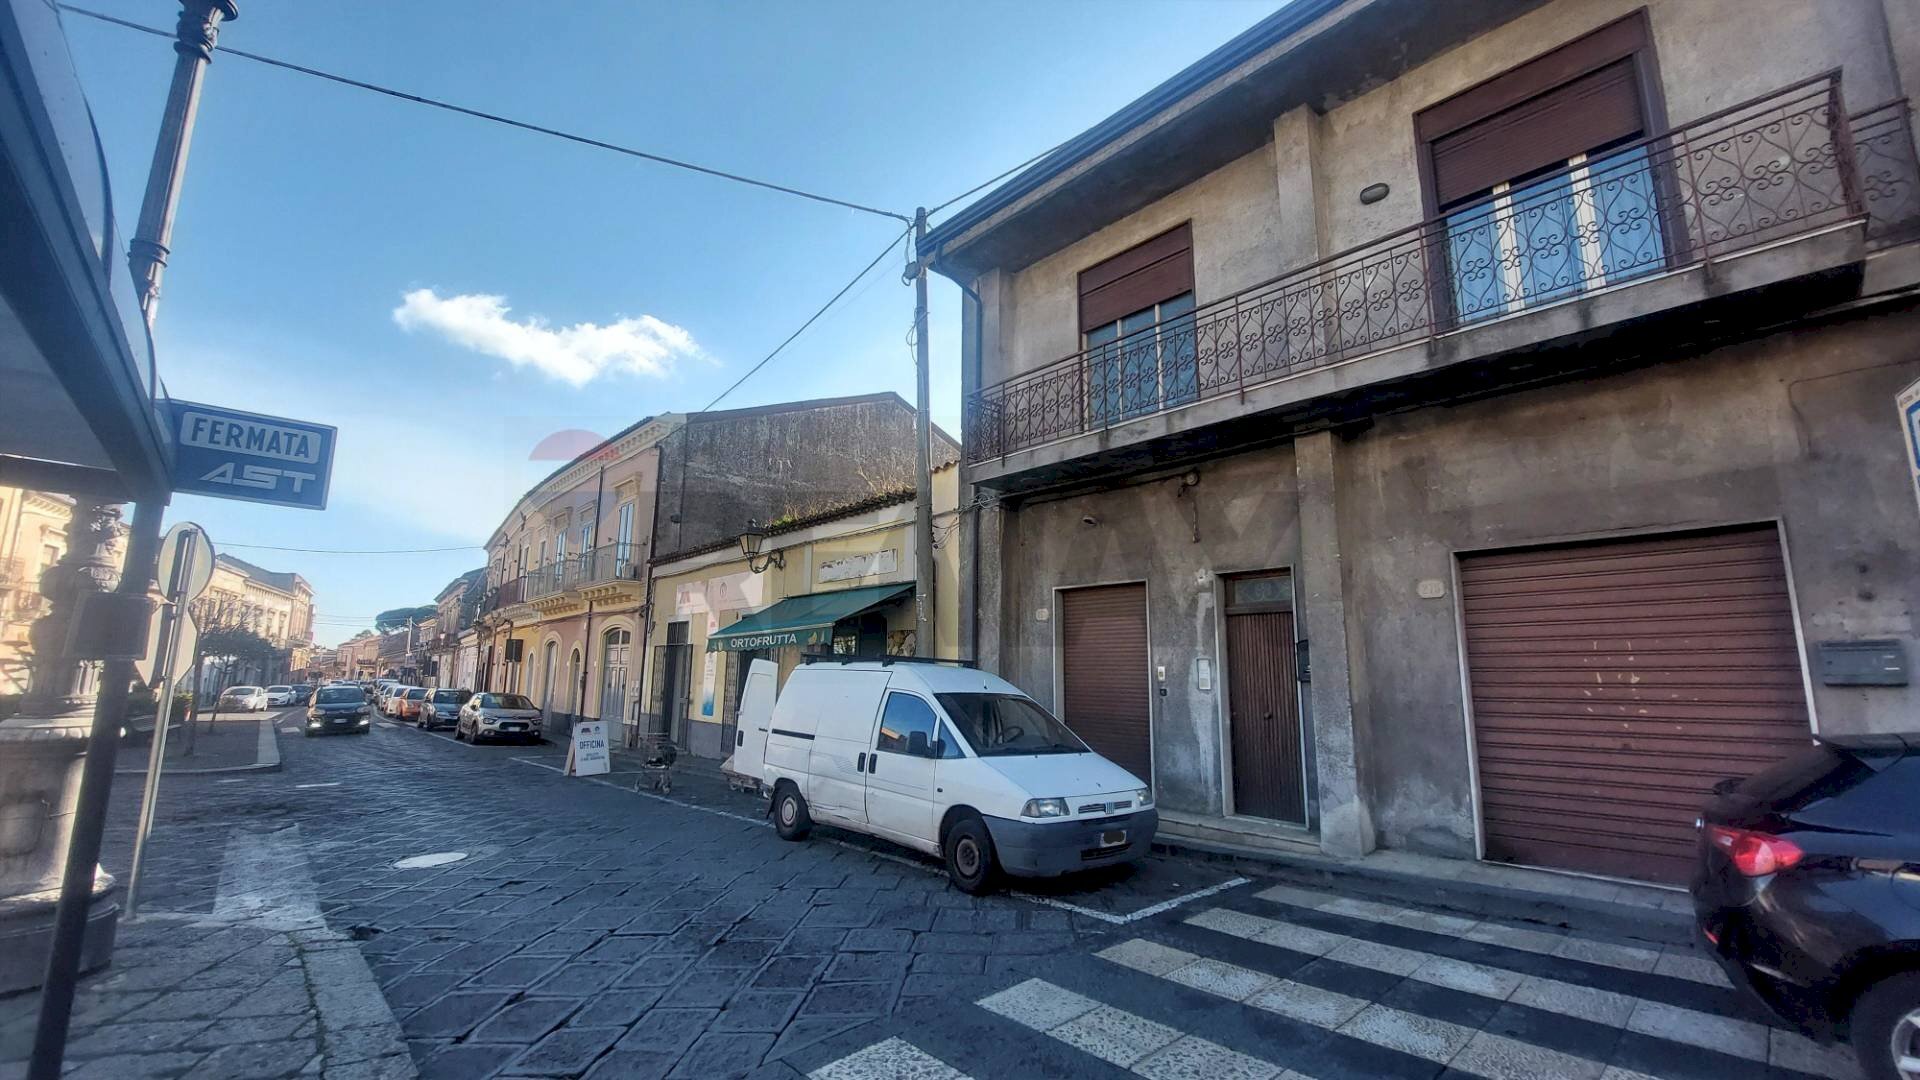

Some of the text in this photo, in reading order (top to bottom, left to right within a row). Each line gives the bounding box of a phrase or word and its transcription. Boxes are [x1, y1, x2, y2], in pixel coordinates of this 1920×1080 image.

[191, 417, 310, 459] FERMATA
[199, 462, 316, 493] AST
[730, 633, 797, 648] ORTOFRUTTA
[580, 740, 605, 750] OFFICINA
